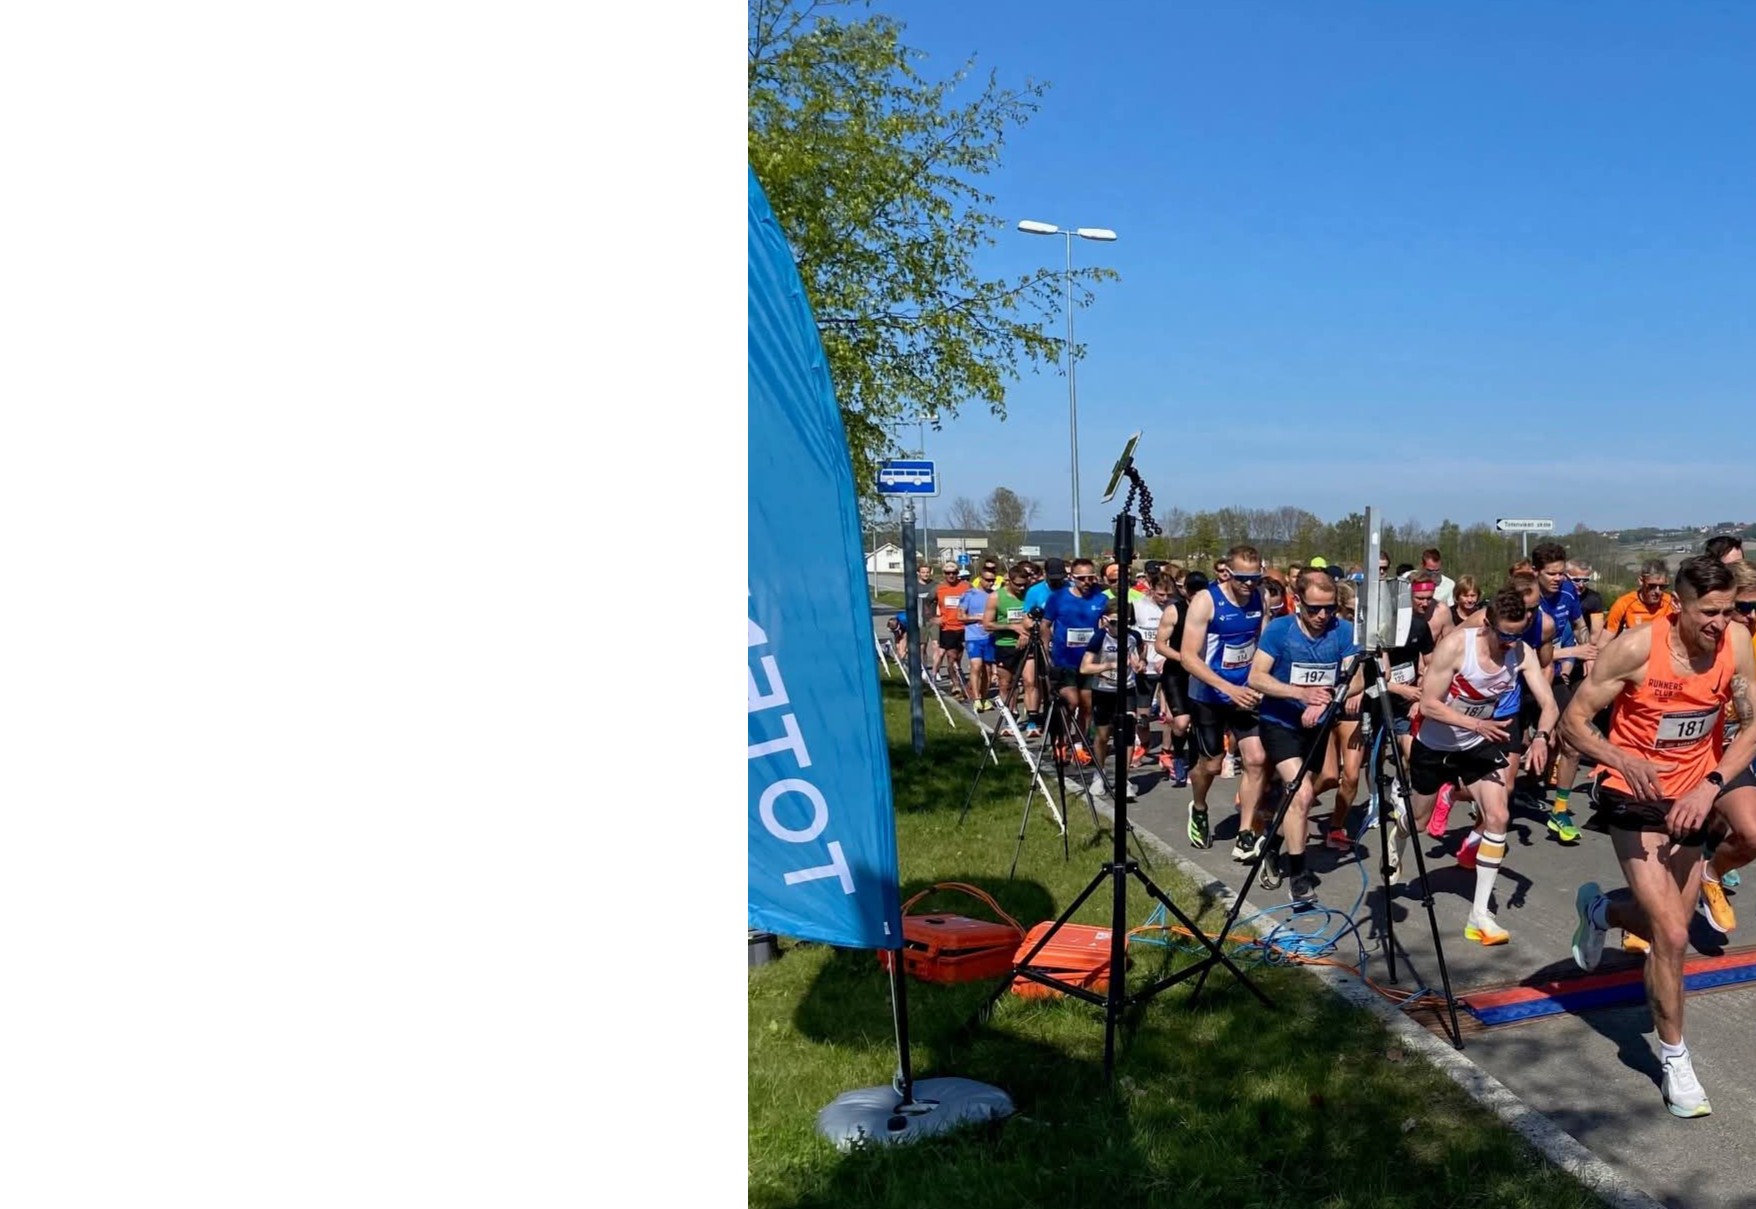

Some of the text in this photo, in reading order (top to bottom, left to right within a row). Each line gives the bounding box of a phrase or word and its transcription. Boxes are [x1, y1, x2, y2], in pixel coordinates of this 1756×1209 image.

[1304, 671, 1326, 683] 197
[1648, 678, 1684, 691] RUNNERS
[1654, 689, 1673, 697] CLUB
[1464, 706, 1486, 717] 187
[1678, 719, 1706, 737] 181
